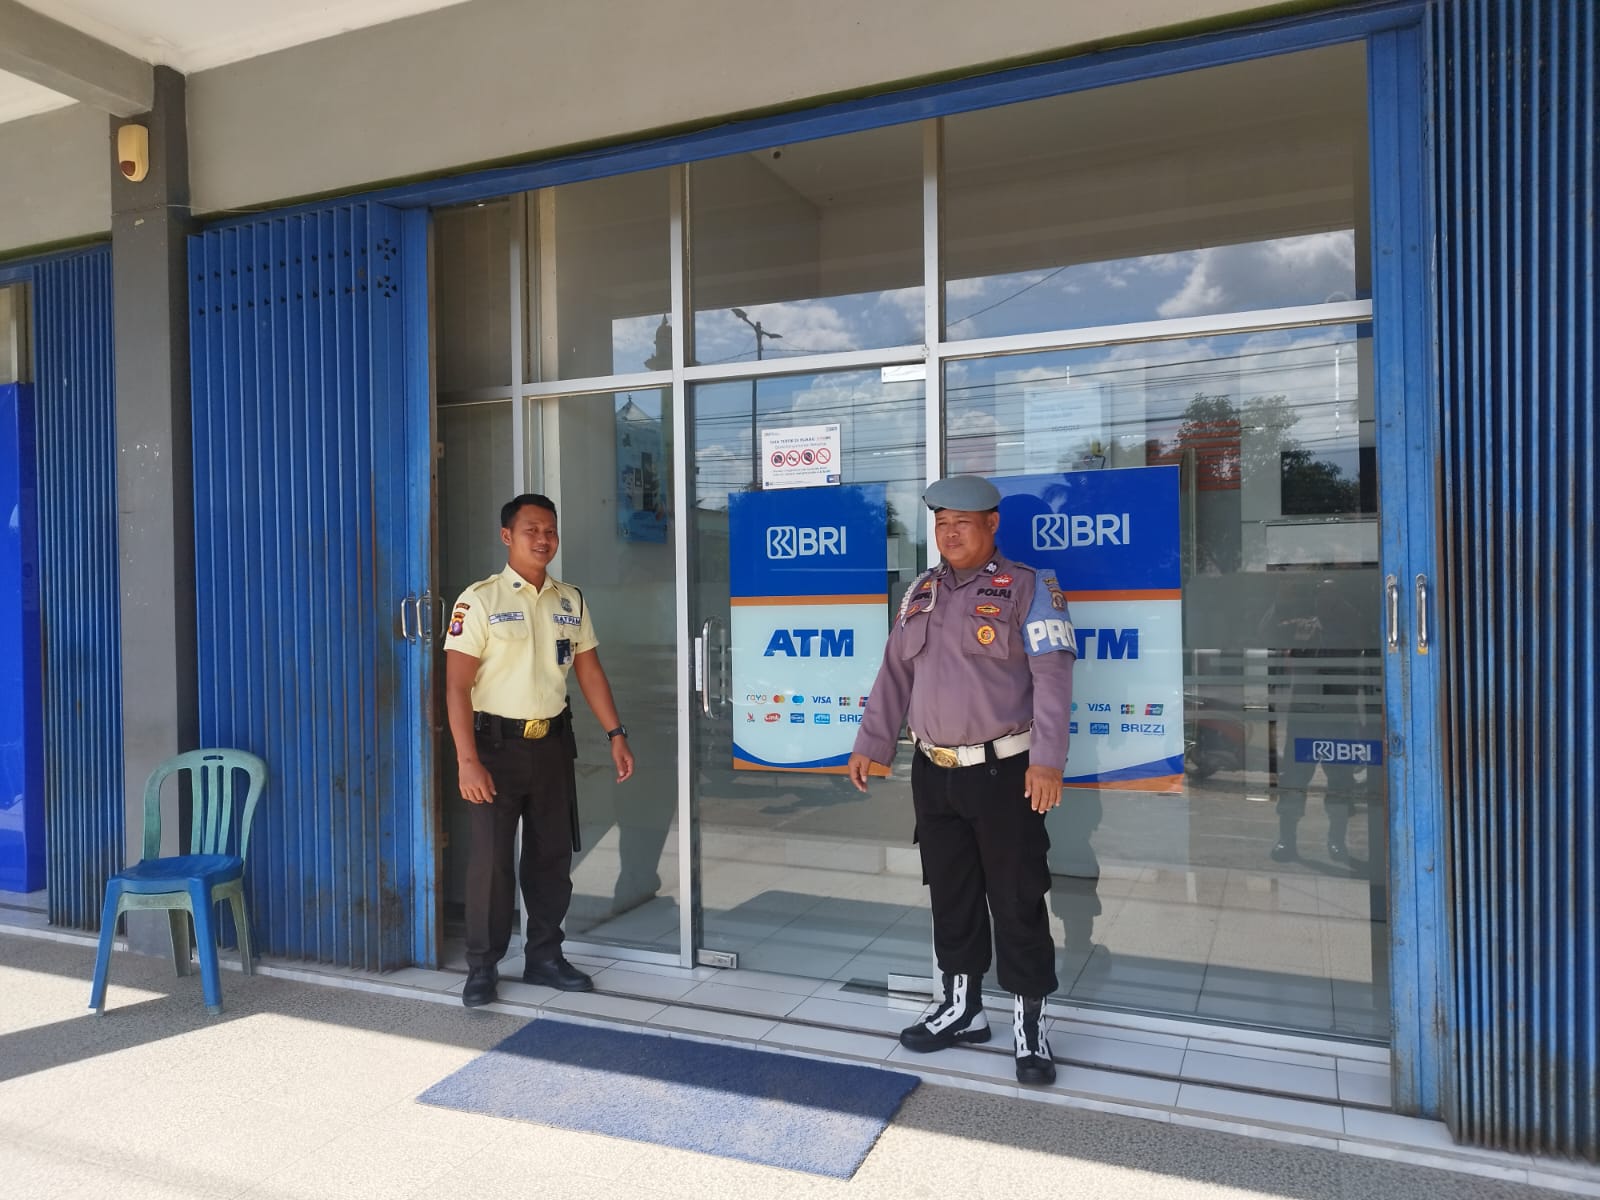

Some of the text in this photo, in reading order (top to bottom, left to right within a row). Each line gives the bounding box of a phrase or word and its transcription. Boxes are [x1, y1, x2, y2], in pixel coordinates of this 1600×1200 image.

[1071, 513, 1130, 546] BRI
[798, 526, 847, 556] BRI
[976, 588, 1012, 599] POLRI
[763, 629, 854, 657] ATM
[1074, 628, 1139, 660] TM
[812, 695, 832, 704] VISA
[1086, 703, 1112, 712] VISA
[839, 714, 864, 723] BRIZ
[1120, 723, 1165, 734] BRIZZI
[1336, 743, 1372, 761] BRI
